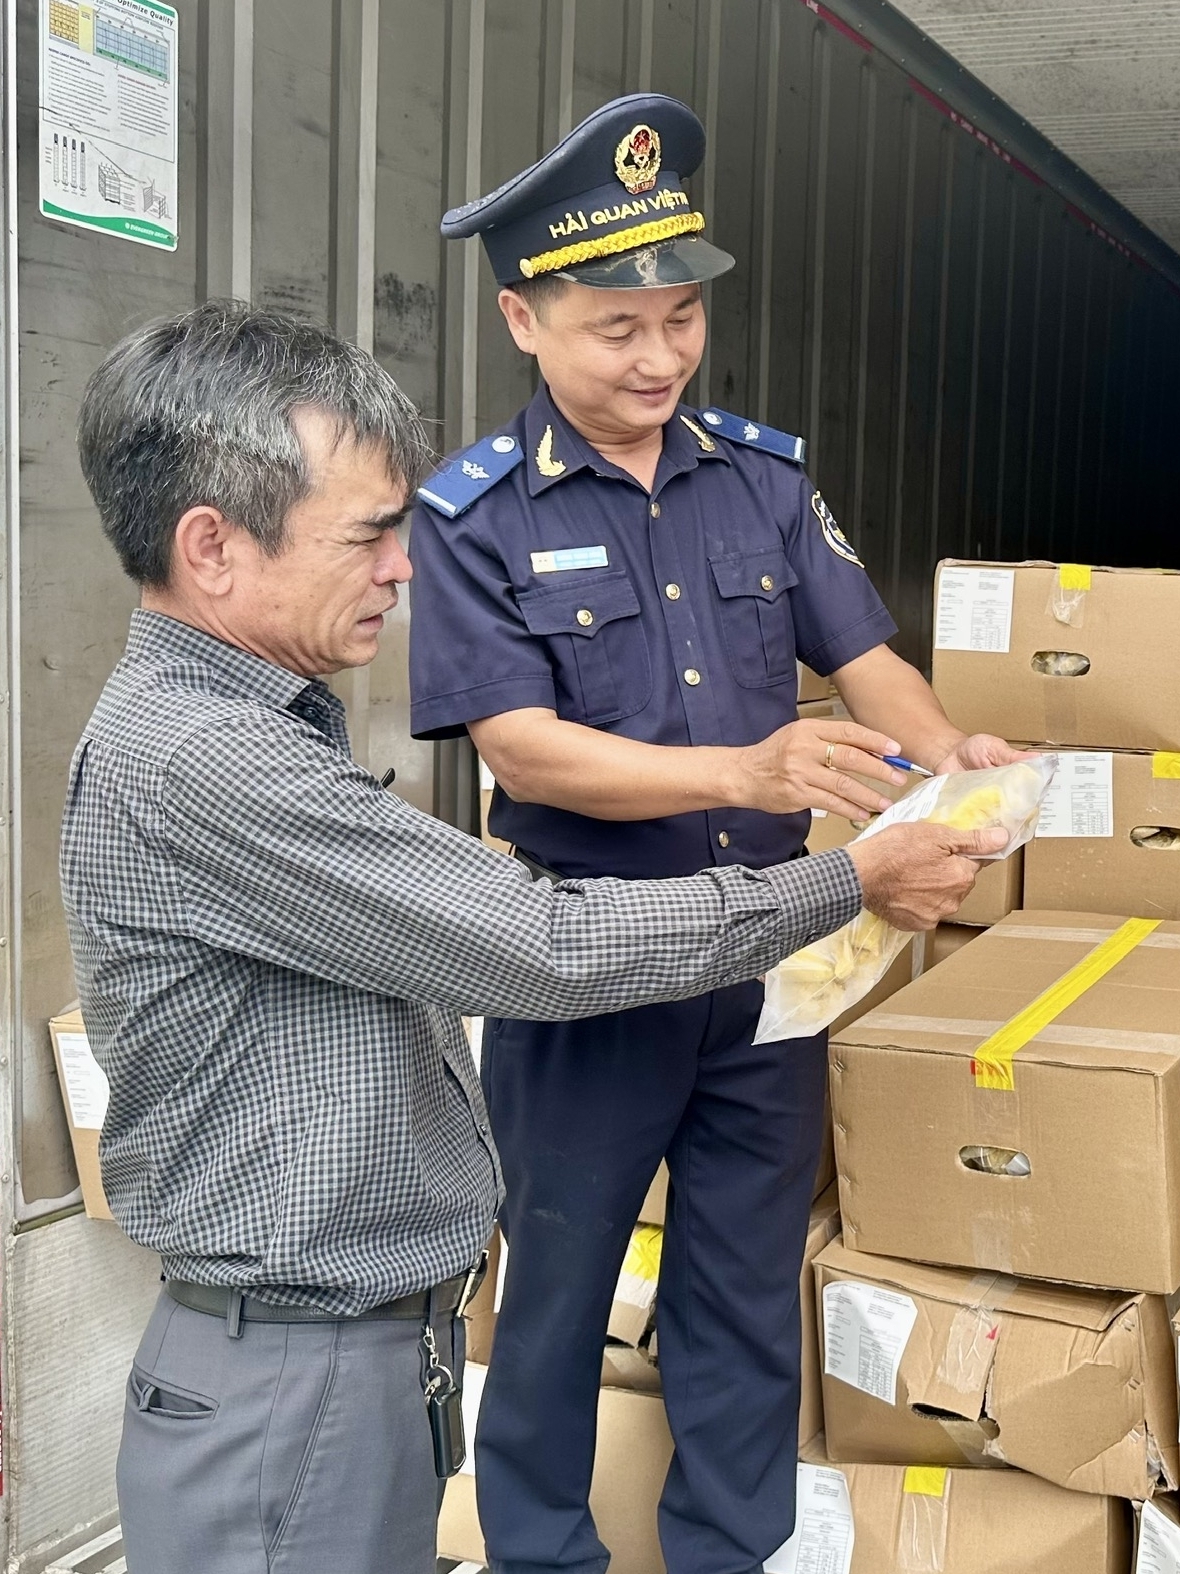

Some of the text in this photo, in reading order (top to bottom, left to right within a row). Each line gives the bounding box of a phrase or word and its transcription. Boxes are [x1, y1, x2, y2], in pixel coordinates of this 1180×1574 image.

[150, 10, 174, 26] Quality
[548, 210, 589, 239] HẢI
[590, 199, 649, 225] QUAN
